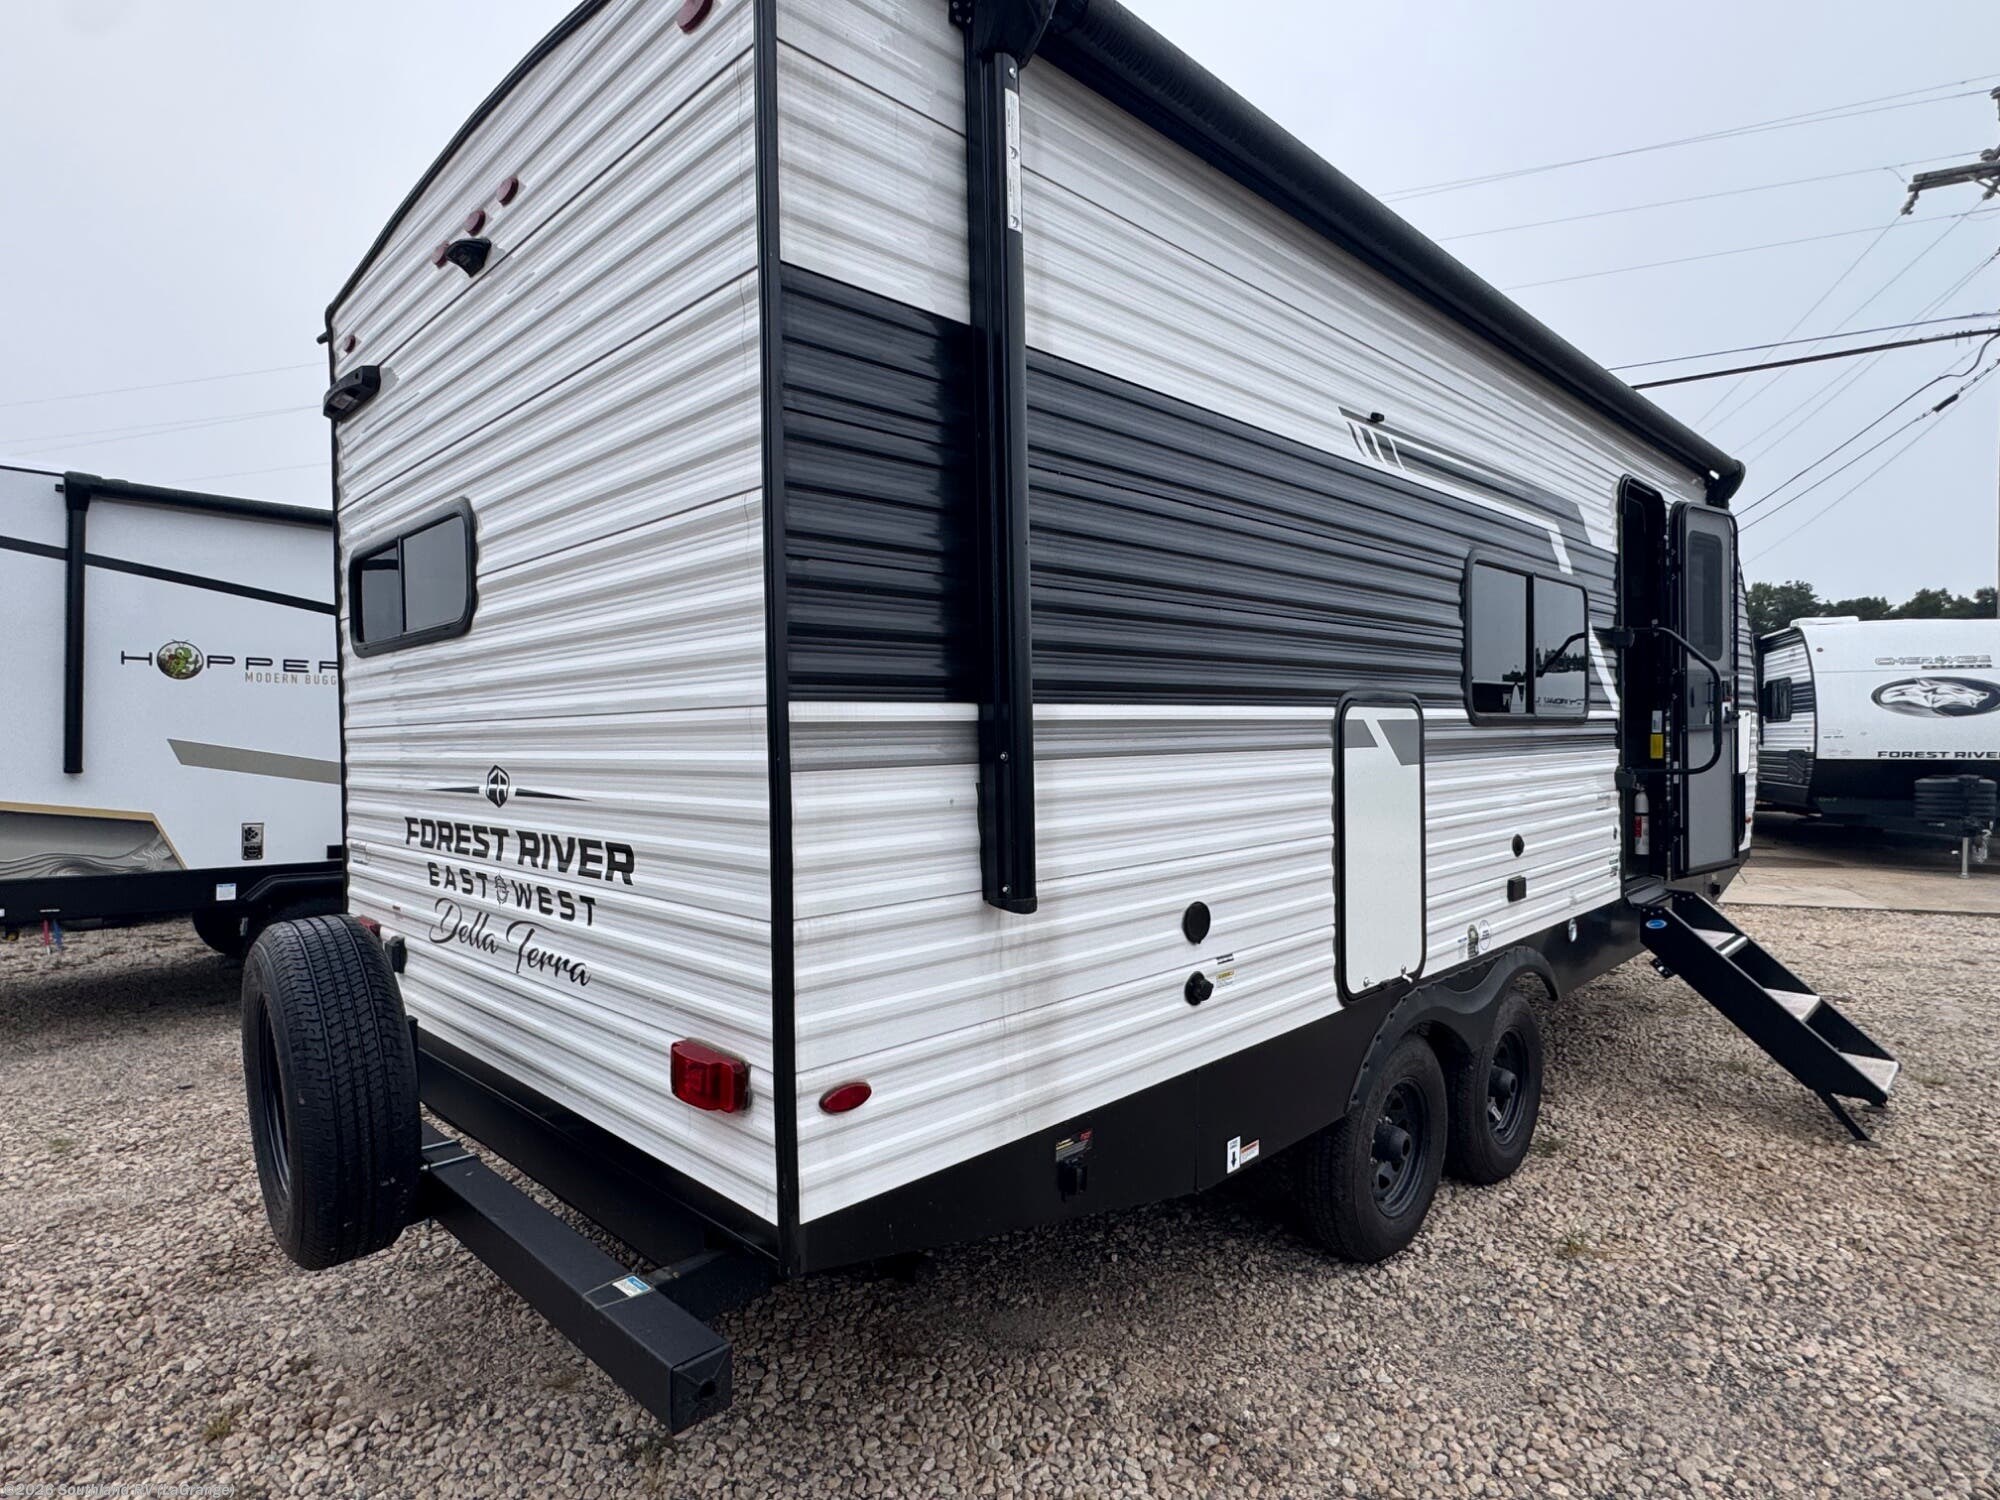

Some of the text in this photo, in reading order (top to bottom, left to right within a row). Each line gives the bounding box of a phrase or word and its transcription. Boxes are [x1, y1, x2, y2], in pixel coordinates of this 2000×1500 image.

[244, 672, 338, 686] MODERN BUGG
[1877, 750, 2000, 759] FOREST RIVE
[404, 816, 510, 862] FOREST
[516, 830, 635, 886] RIVER
[427, 861, 597, 927] EAST WEST
[428, 897, 592, 987] Della Terra
